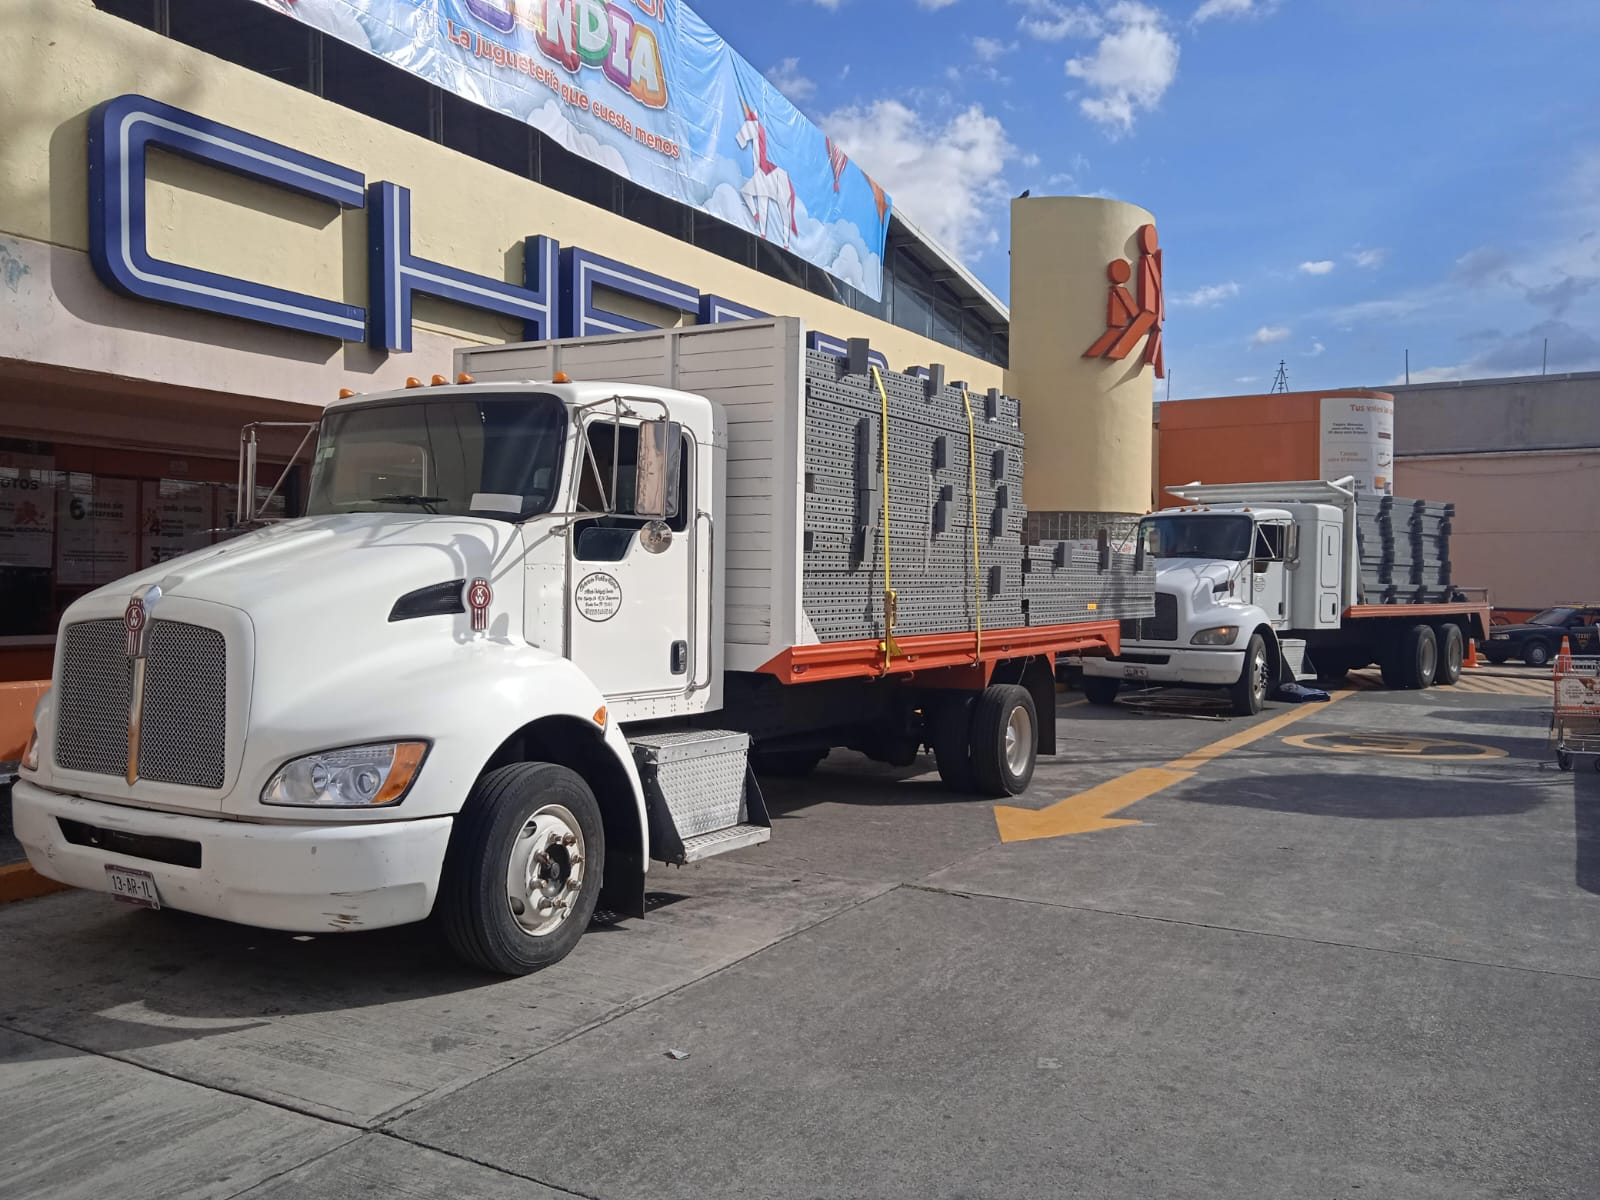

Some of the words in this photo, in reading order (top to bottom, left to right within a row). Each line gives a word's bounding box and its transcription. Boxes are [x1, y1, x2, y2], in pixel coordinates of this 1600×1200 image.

[447, 19, 471, 49] La
[561, 83, 589, 110] que
[592, 100, 633, 137] cuesta
[634, 124, 680, 160] menos
[69, 499, 86, 521] 6
[112, 875, 153, 898] 13-AR-1L
